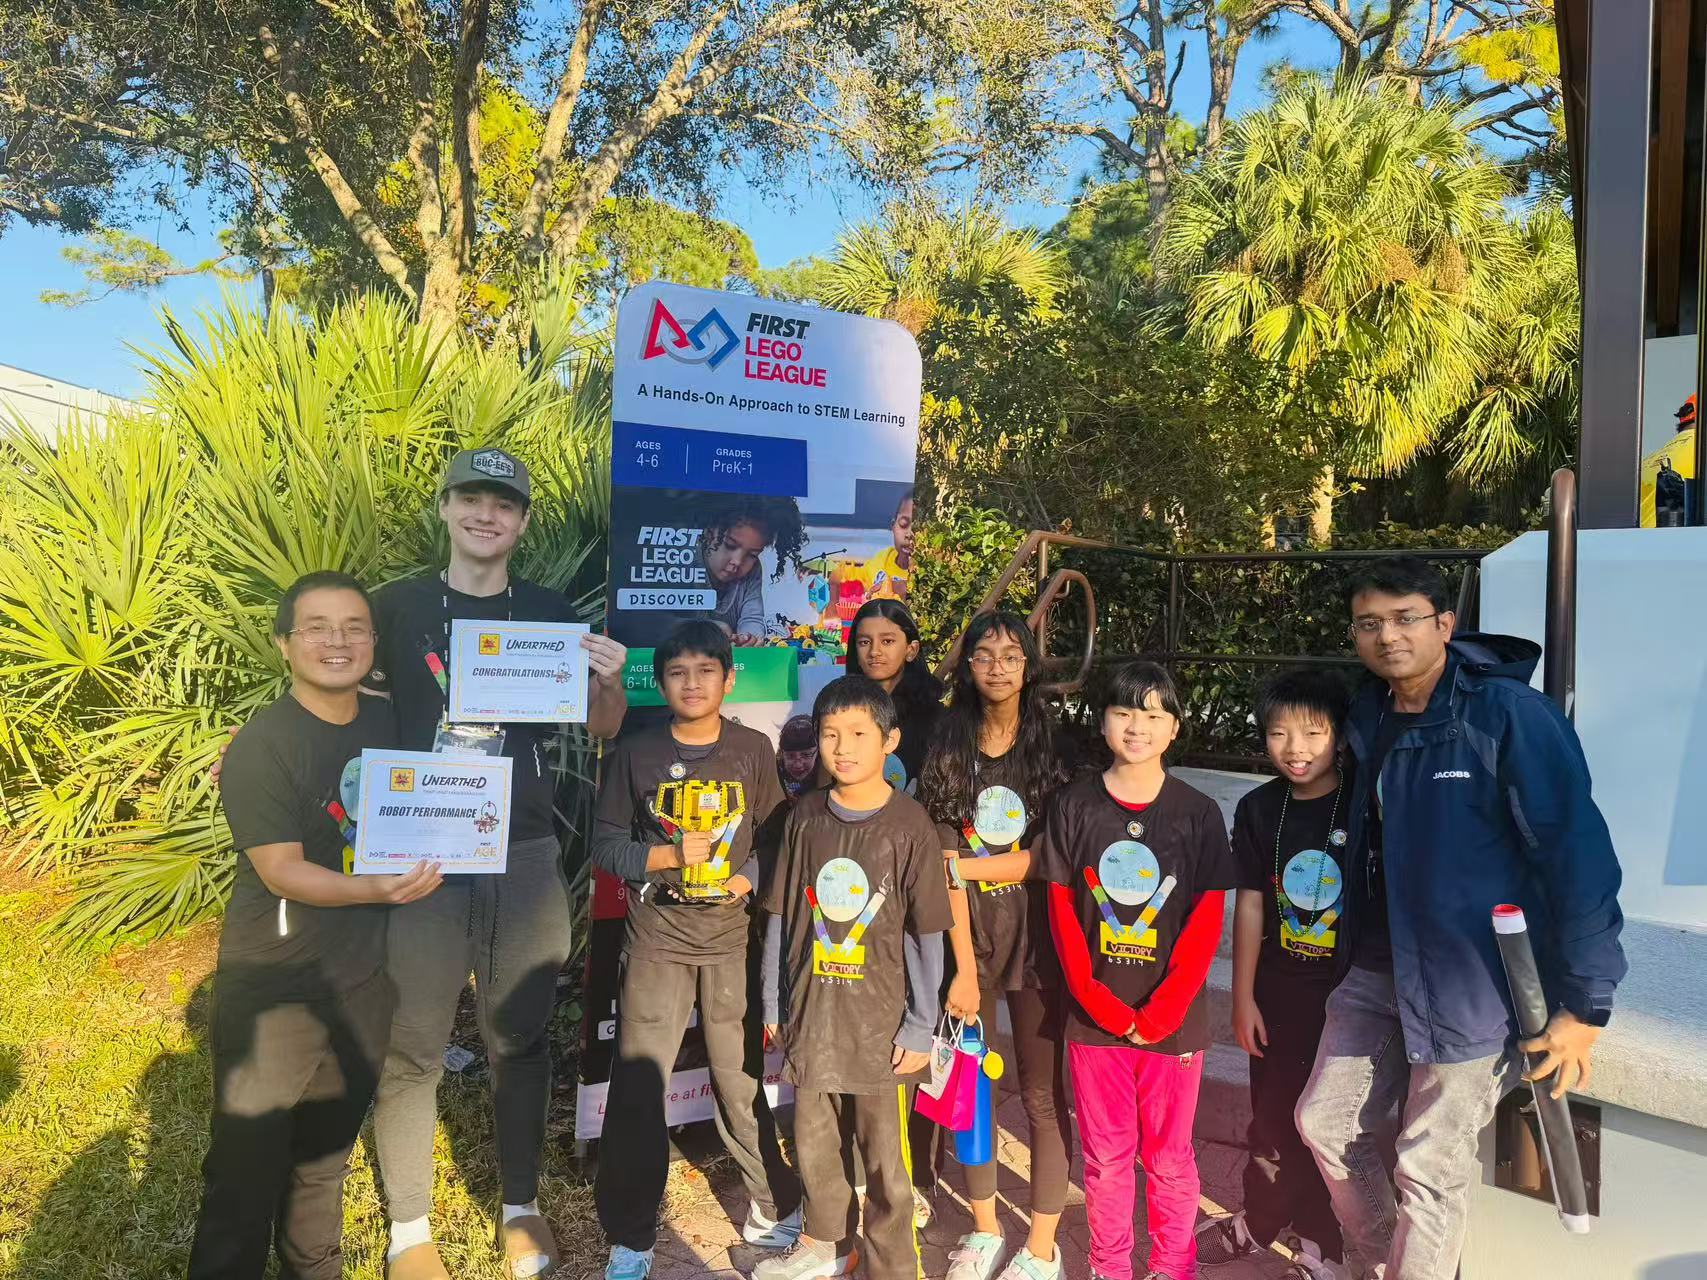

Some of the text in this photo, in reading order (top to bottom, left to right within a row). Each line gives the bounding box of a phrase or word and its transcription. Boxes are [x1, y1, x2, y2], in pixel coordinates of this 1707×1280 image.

[746, 312, 810, 340] FIRST
[745, 336, 802, 361] LEGO
[745, 359, 827, 387] LEAGUE
[637, 383, 905, 427] A Hands-On Approach to STEM Learning
[635, 440, 661, 450] AGES
[716, 448, 752, 458] GRADES
[636, 453, 659, 468] 4-6
[712, 459, 753, 475] PreK-1
[637, 526, 703, 547] FIRST
[642, 547, 694, 565] LEGO
[630, 566, 706, 583] LEAGUE
[630, 594, 704, 605] DISCOVER
[506, 639, 565, 652] UNEARTHED
[421, 774, 487, 789] UNEARTHED
[1433, 770, 1471, 780] JACOBS
[379, 805, 477, 818] ROBOT PERFORMANCE
[990, 884, 1022, 897] 65314
[1110, 943, 1152, 957] VICTORY
[1290, 941, 1330, 954] VICTORY
[822, 961, 861, 975] VICTORY
[1108, 955, 1144, 967] 65314
[820, 976, 852, 986] 65314
[683, 1087, 696, 1100] at
